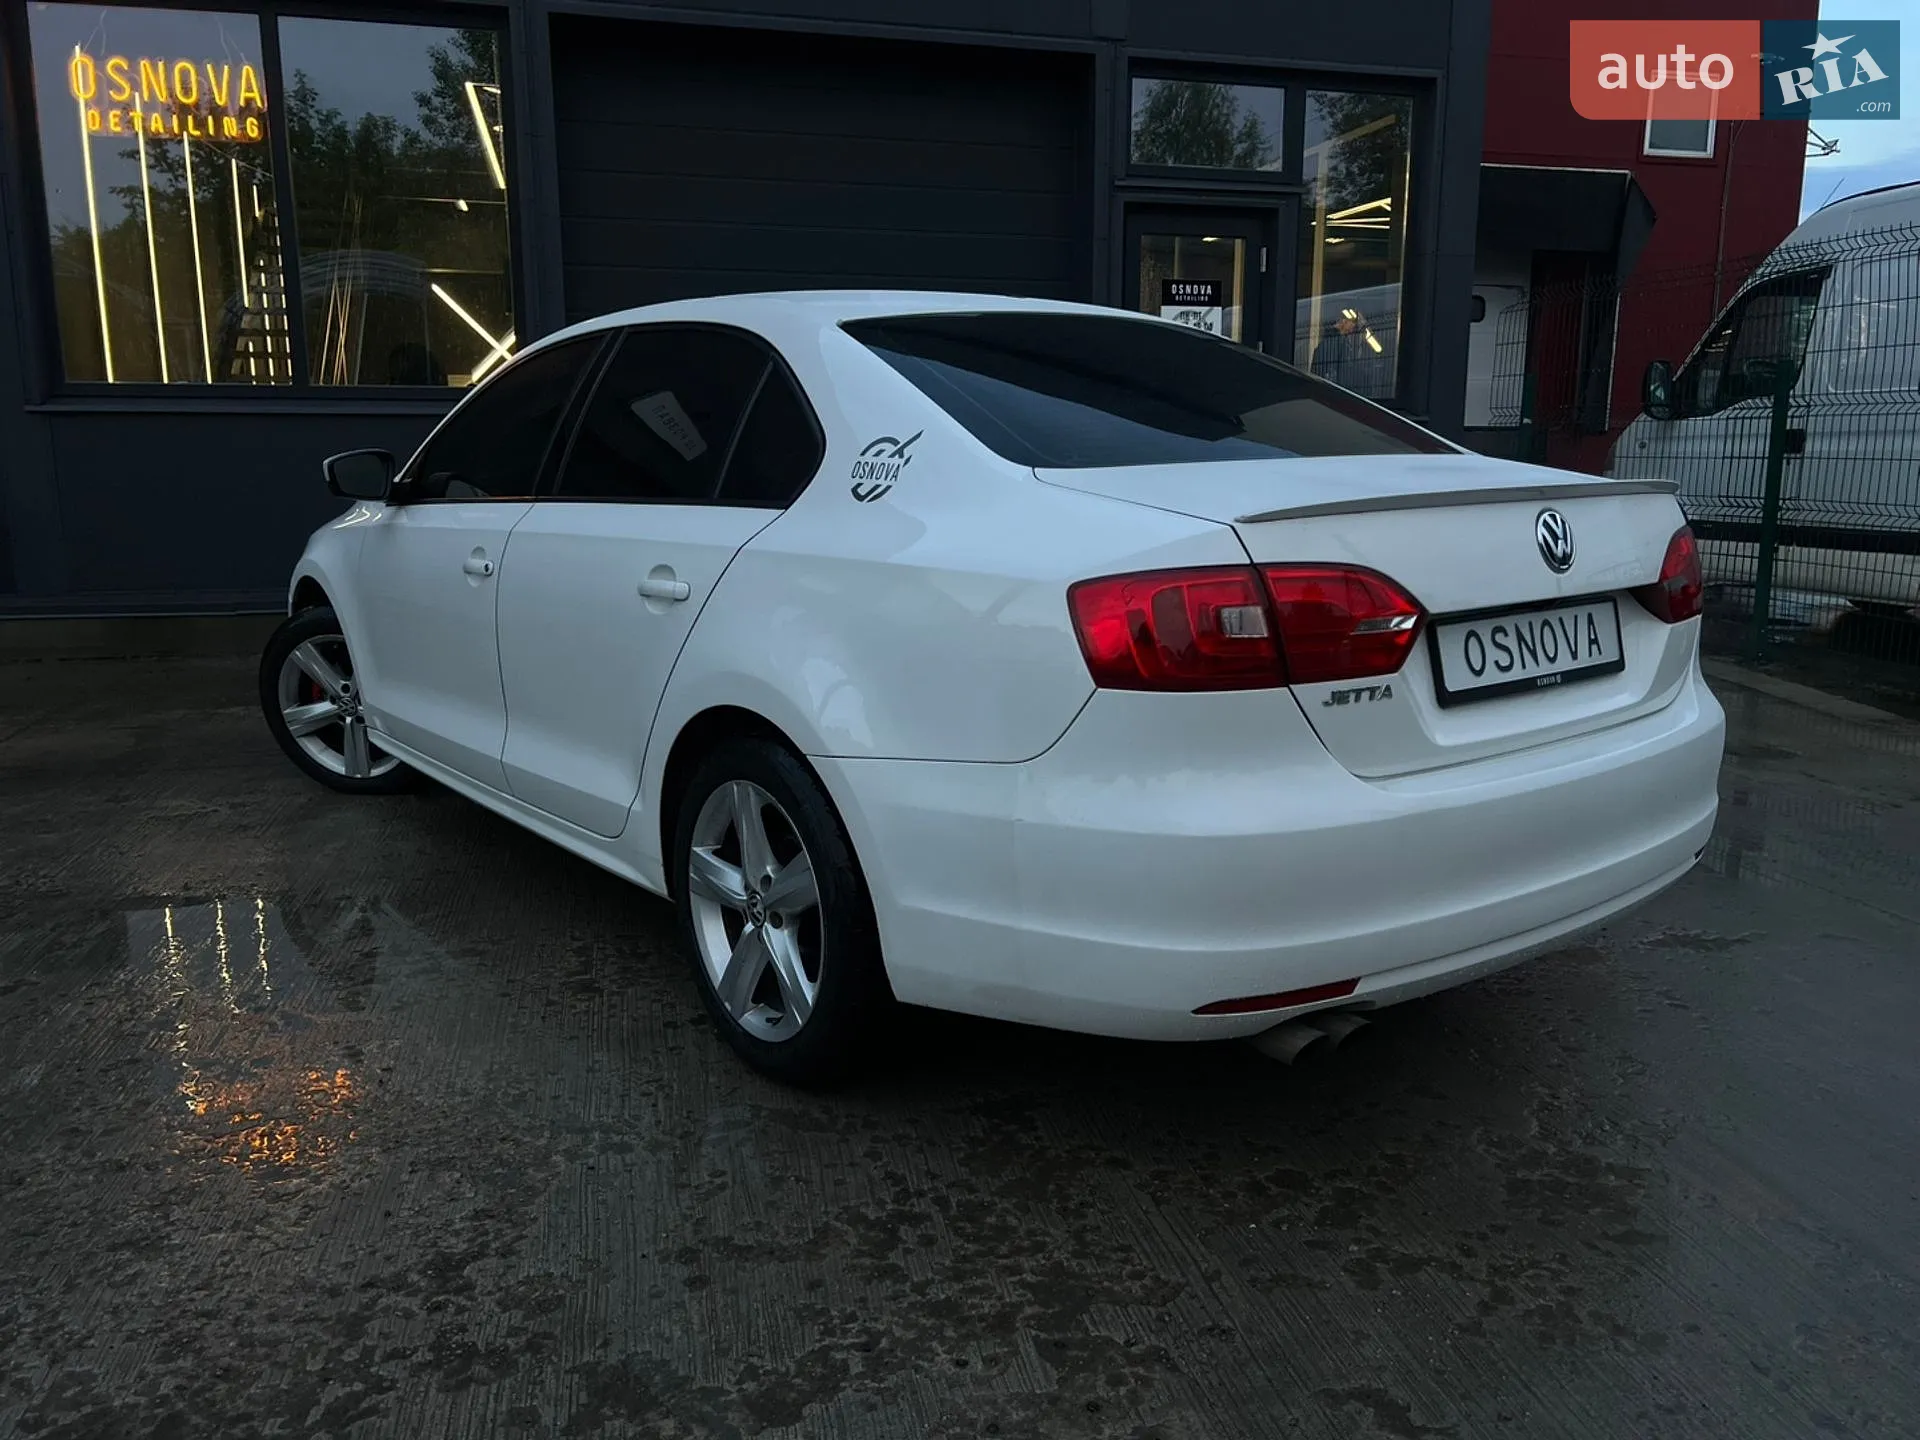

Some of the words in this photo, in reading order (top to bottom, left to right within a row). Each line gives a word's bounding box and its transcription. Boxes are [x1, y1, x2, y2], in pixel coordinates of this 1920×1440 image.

[70, 55, 264, 109] OSNOVA
[87, 109, 260, 138] DETAILING
[1171, 284, 1212, 295] OSNOVA
[850, 460, 899, 482] OSNOVA
[1463, 611, 1603, 678] OSNOVA
[1322, 684, 1393, 707] JETTA
